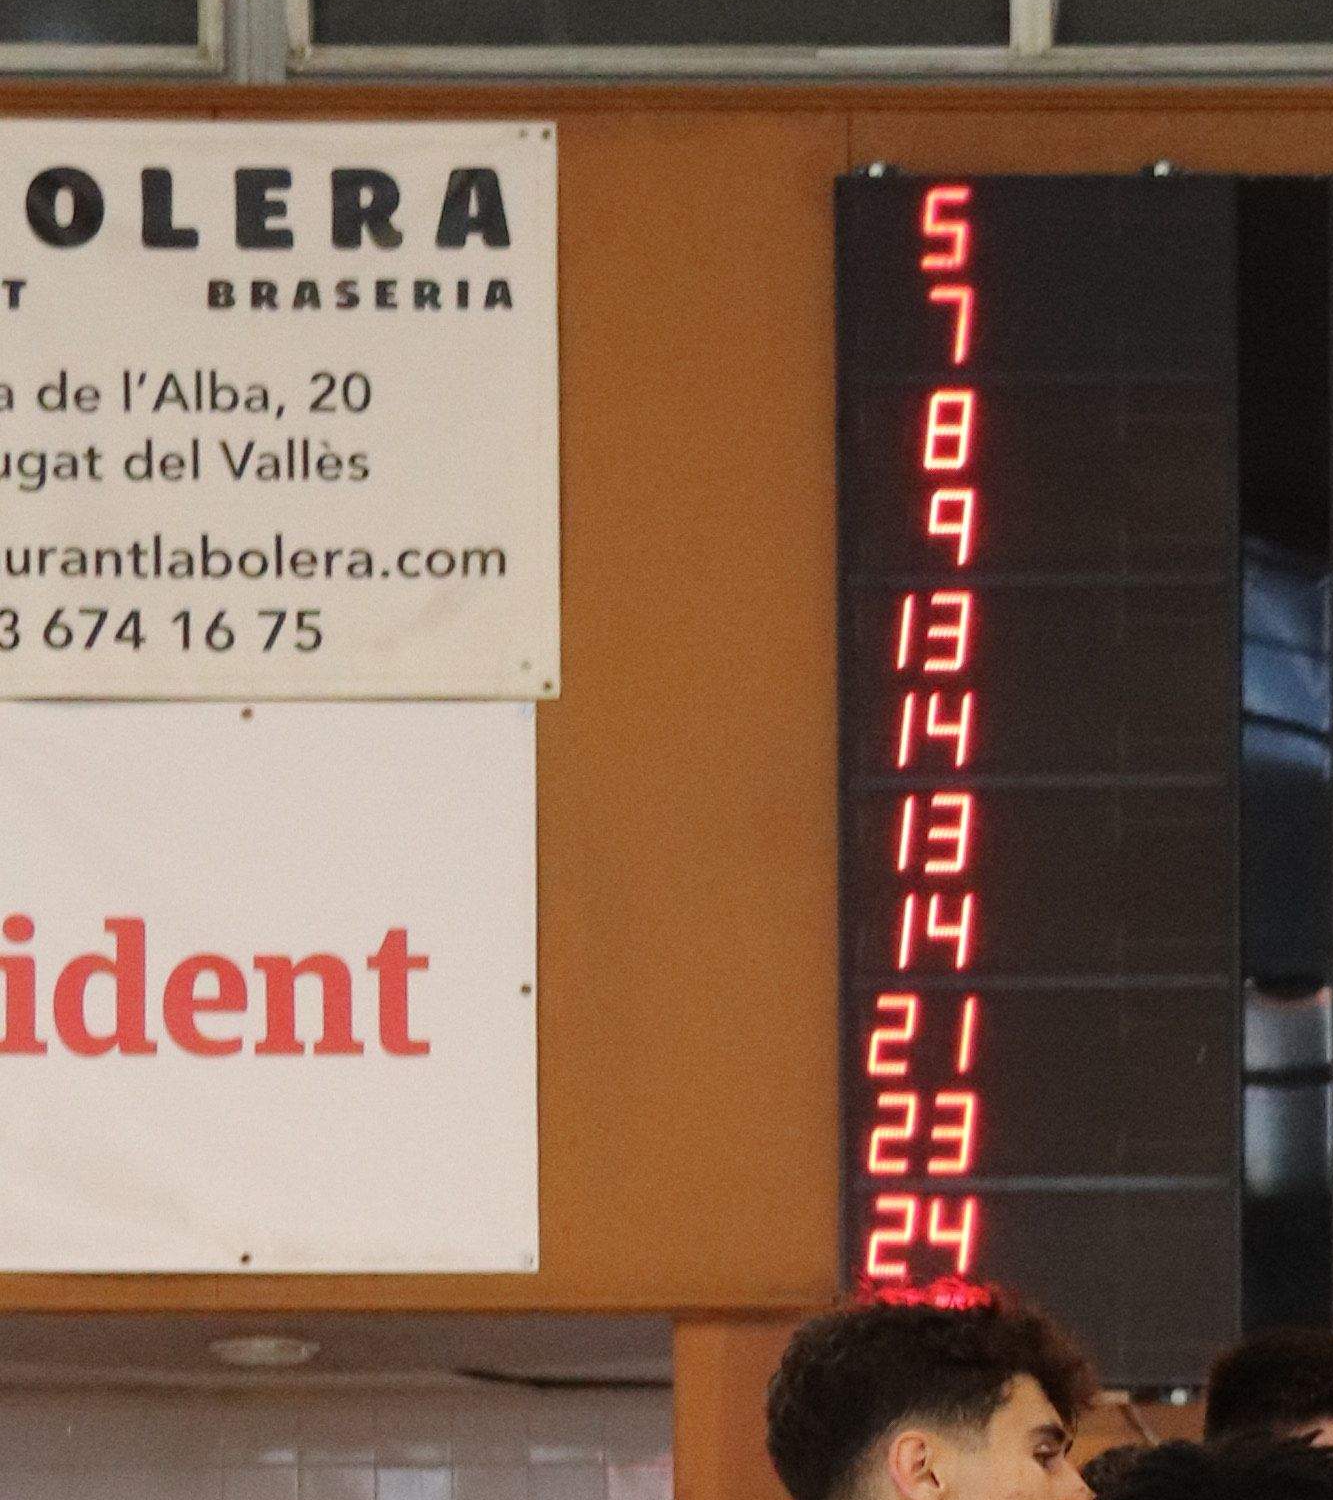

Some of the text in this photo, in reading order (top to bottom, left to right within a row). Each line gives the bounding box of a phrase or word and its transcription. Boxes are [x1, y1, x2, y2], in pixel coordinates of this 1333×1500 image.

[25, 167, 511, 249] OLERA
[920, 185, 971, 272] 5
[207, 280, 513, 310] BRASERIA
[929, 284, 975, 365] 7
[37, 371, 101, 411] de
[310, 372, 371, 412] 20
[922, 389, 976, 471] 8
[124, 439, 200, 480] del
[220, 438, 370, 481] Vallès
[6, 534, 507, 578] urantlabolera.com
[928, 487, 976, 566] 9
[42, 608, 146, 650] 674
[172, 609, 236, 651] 16
[258, 609, 323, 651] 75
[895, 588, 976, 674] 13
[896, 690, 976, 770] 14
[895, 791, 976, 877] 13
[896, 891, 976, 971] 14
[1, 913, 431, 1057] ident
[866, 992, 979, 1080] 21
[865, 1090, 978, 1177] 23
[864, 1194, 978, 1278] 24
